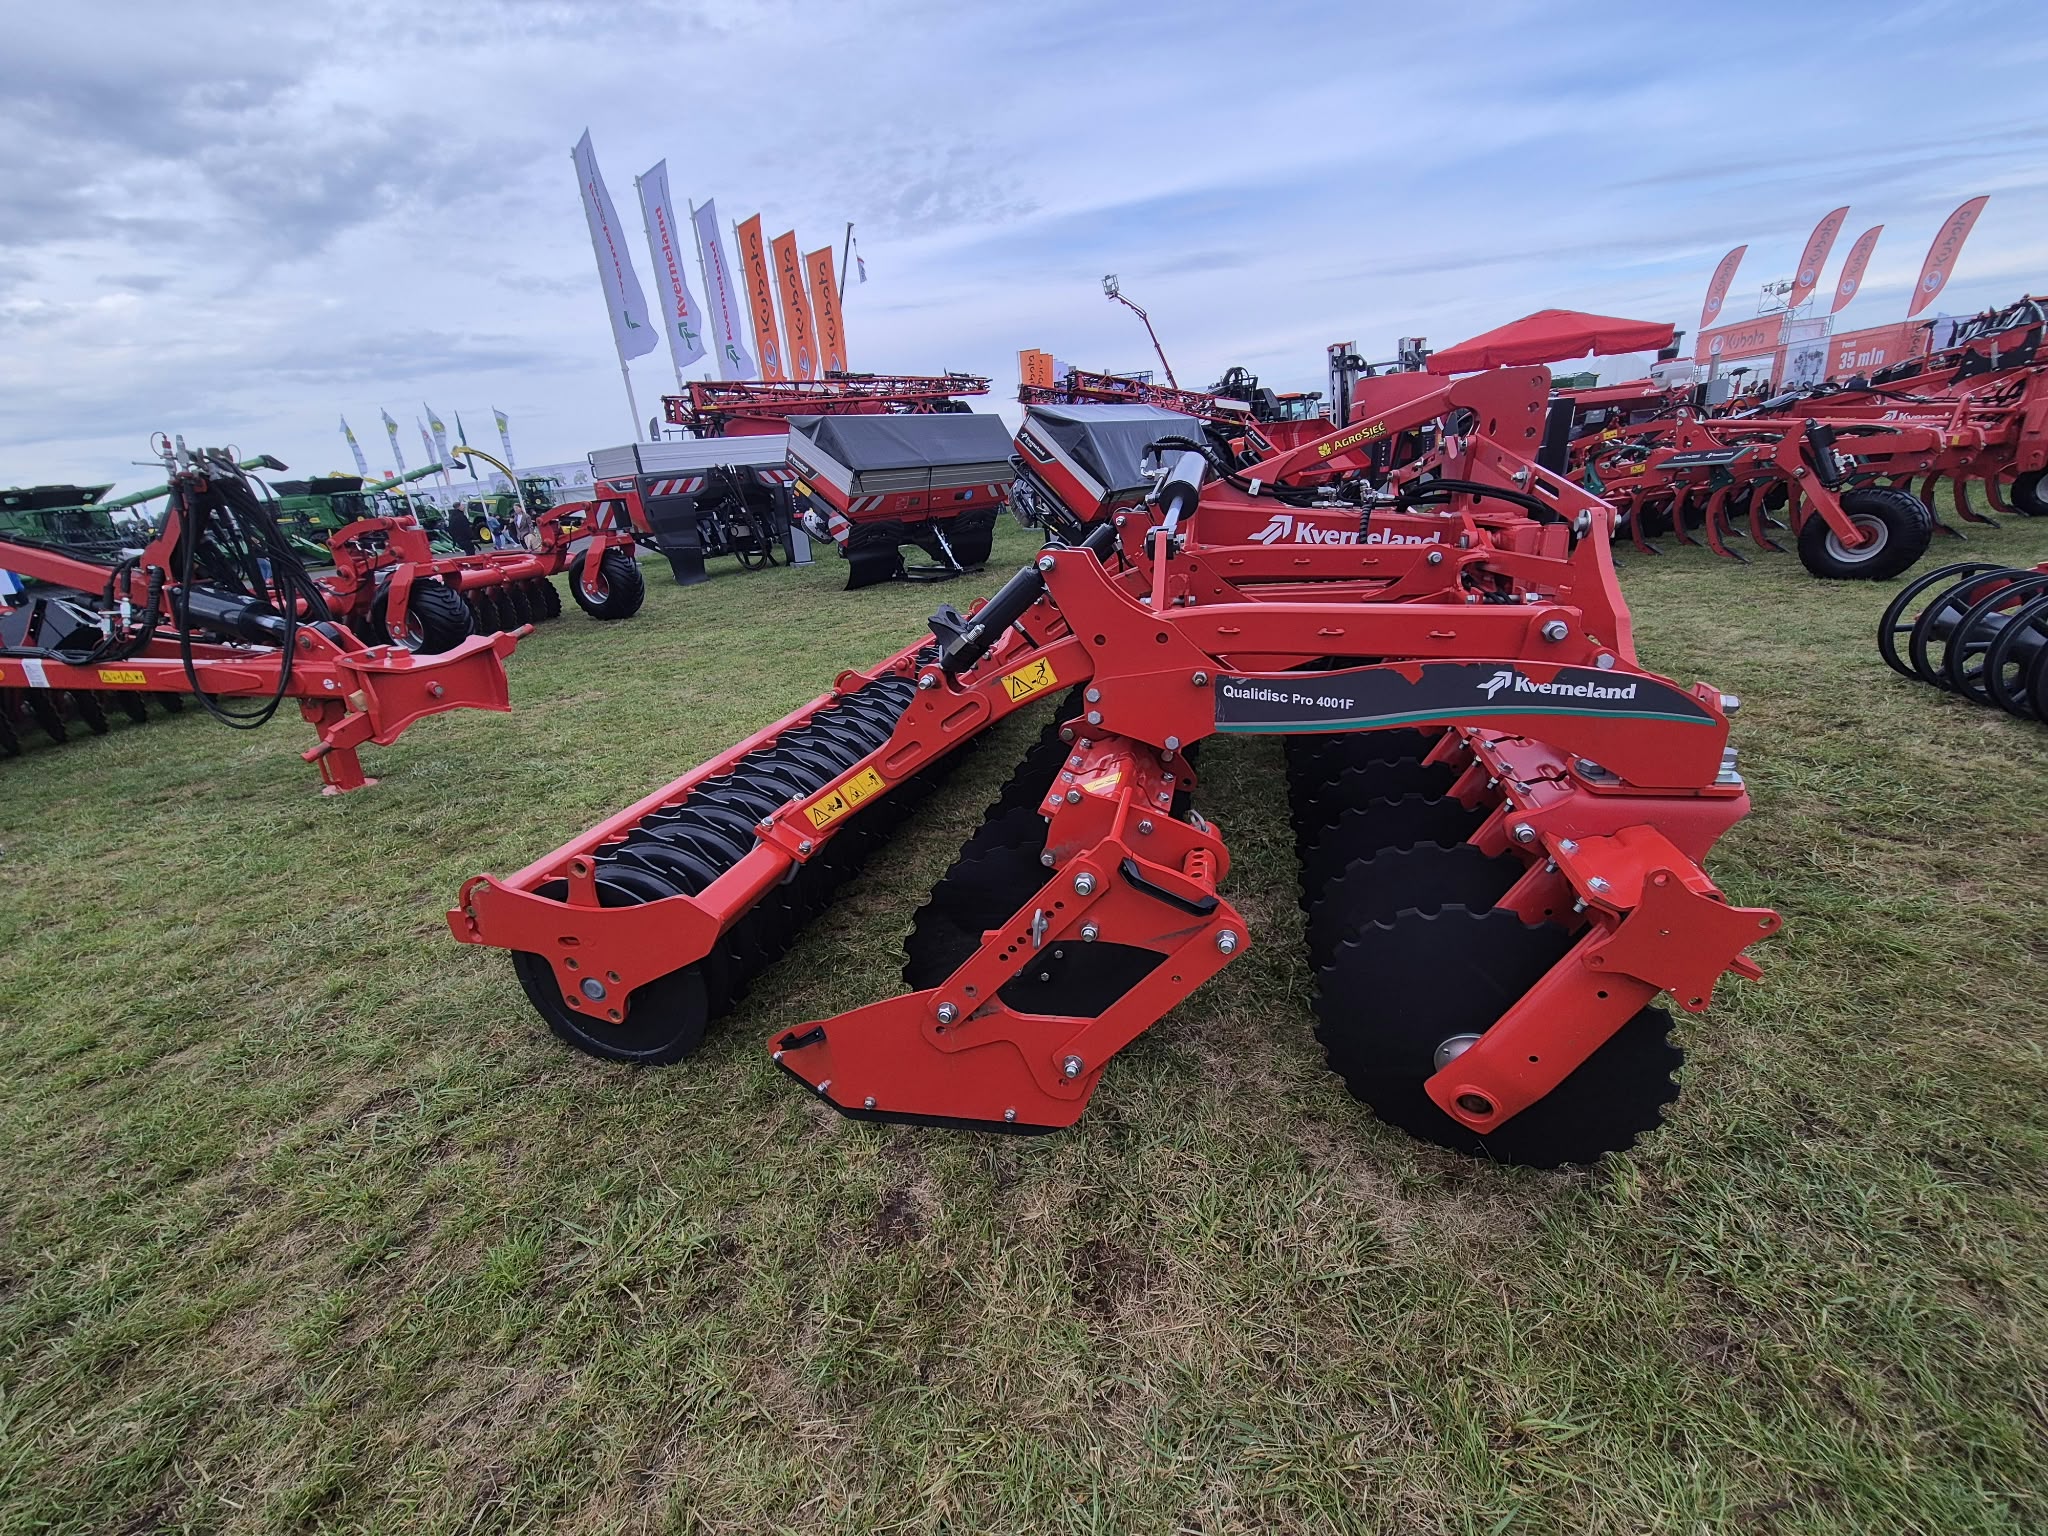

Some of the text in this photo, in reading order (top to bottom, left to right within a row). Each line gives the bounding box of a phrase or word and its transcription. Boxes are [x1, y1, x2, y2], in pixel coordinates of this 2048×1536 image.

[1809, 218, 1837, 266] Kubota
[1933, 210, 1972, 267] Kubota
[750, 232, 770, 333] Kubota
[784, 247, 804, 340] Kubota
[818, 261, 836, 348] Kubota
[1726, 329, 1766, 349] Kubota
[1838, 347, 1885, 370] 35 mln
[1223, 684, 1355, 710] Qualidisc Pro 4001F
[1514, 676, 1637, 700] Kverneland
